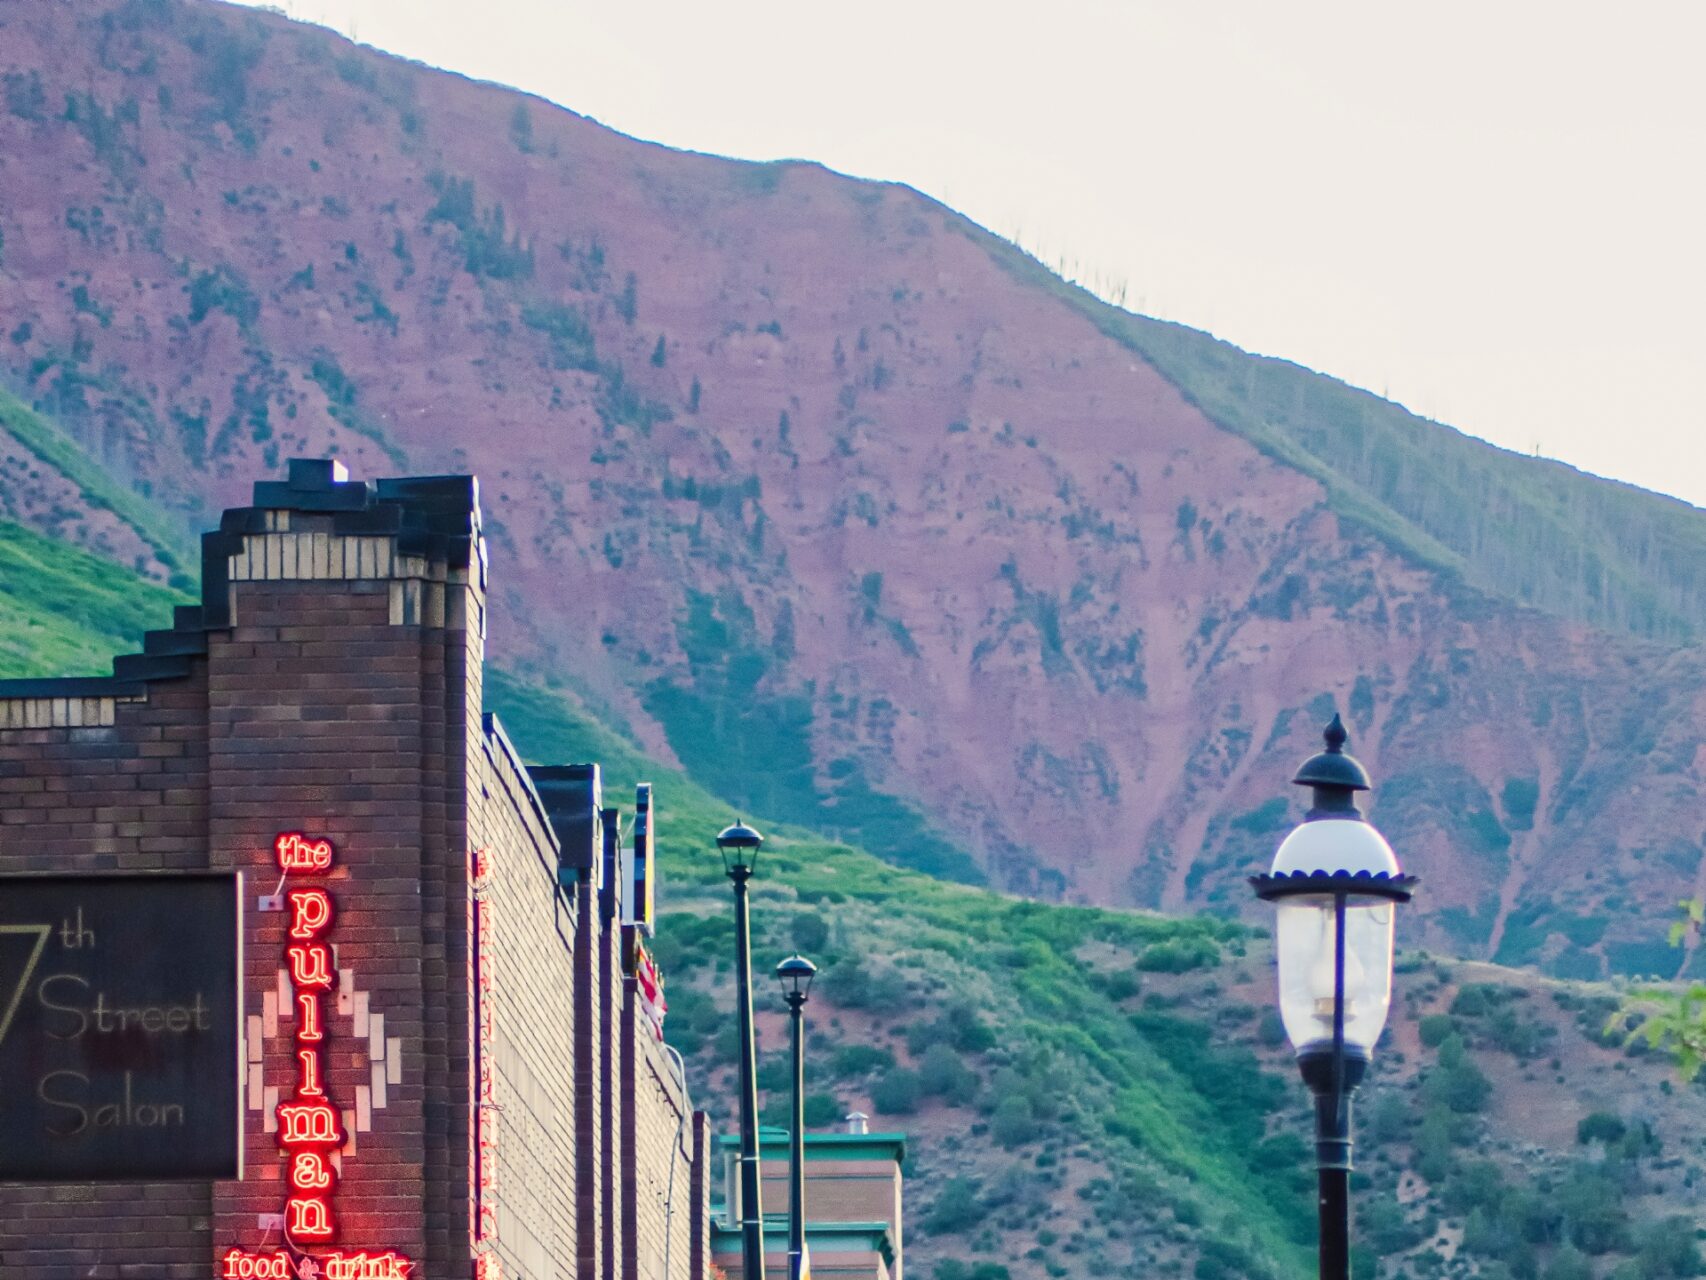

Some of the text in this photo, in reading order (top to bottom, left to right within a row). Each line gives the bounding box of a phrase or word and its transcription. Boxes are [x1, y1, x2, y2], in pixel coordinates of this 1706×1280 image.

[277, 834, 332, 868] the
[39, 974, 211, 1040] Street
[280, 891, 341, 1235] pullman
[39, 1070, 185, 1137] Salon
[223, 1250, 291, 1280] food
[325, 1252, 408, 1280] drink
